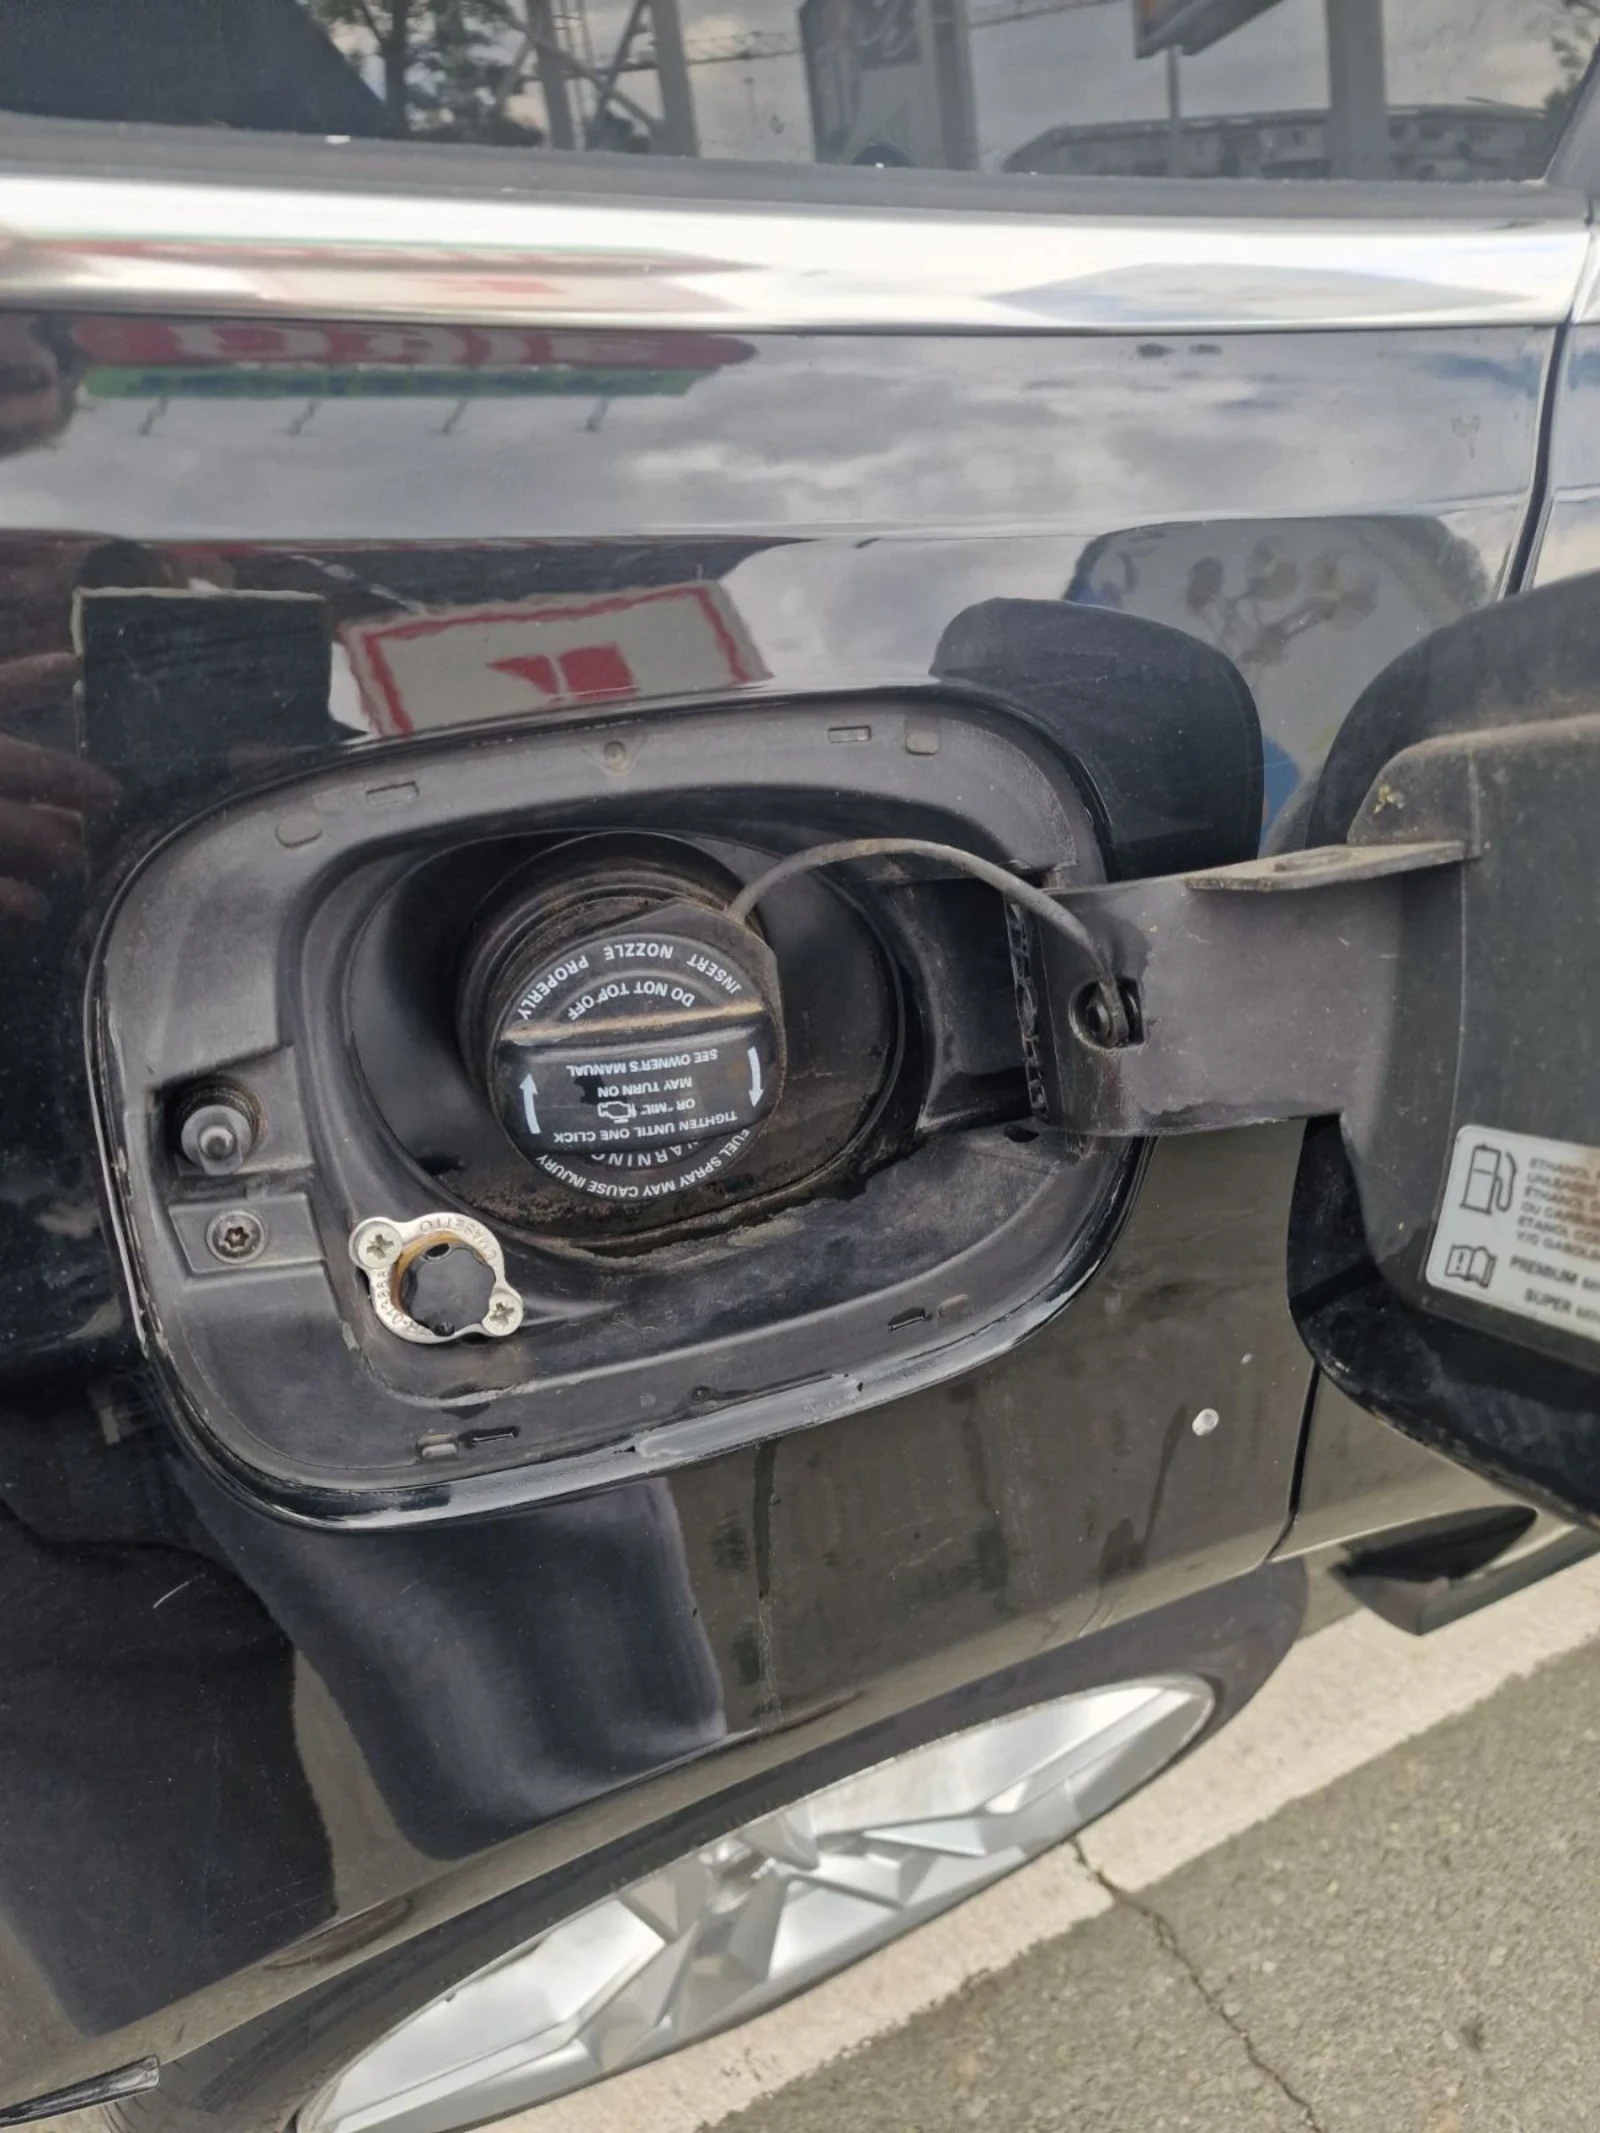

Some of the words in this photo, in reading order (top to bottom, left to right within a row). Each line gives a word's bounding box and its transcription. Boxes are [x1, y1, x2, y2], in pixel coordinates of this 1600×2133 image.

[603, 943, 674, 961] NOZZLE
[686, 953, 742, 995] INSERT
[518, 955, 589, 1020] PROPERLY
[597, 982, 630, 1003] TOP
[633, 980, 668, 997] NOT
[671, 987, 696, 1008] DO
[568, 996, 594, 1020] OFF
[629, 1053, 690, 1072] OWNER'S
[694, 1048, 718, 1064] SEE
[565, 1062, 626, 1077] MANUAL
[597, 1085, 619, 1098] ON
[622, 1081, 660, 1095] TURN
[664, 1076, 693, 1091] MAY
[676, 1098, 696, 1111] OR
[679, 1110, 738, 1130] TIGHTEN
[554, 1131, 596, 1143] CLICK
[601, 1128, 630, 1141] ONE
[634, 1122, 674, 1137] UNTIL
[720, 1128, 750, 1157] FUEL
[536, 1154, 586, 1184] INJURY
[679, 1156, 722, 1188] SPRAY
[586, 1180, 638, 1198] CAUSE
[643, 1180, 676, 1197] MAY
[1509, 1253, 1578, 1286] PREMIUM
[1525, 1287, 1572, 1314] SUPER
